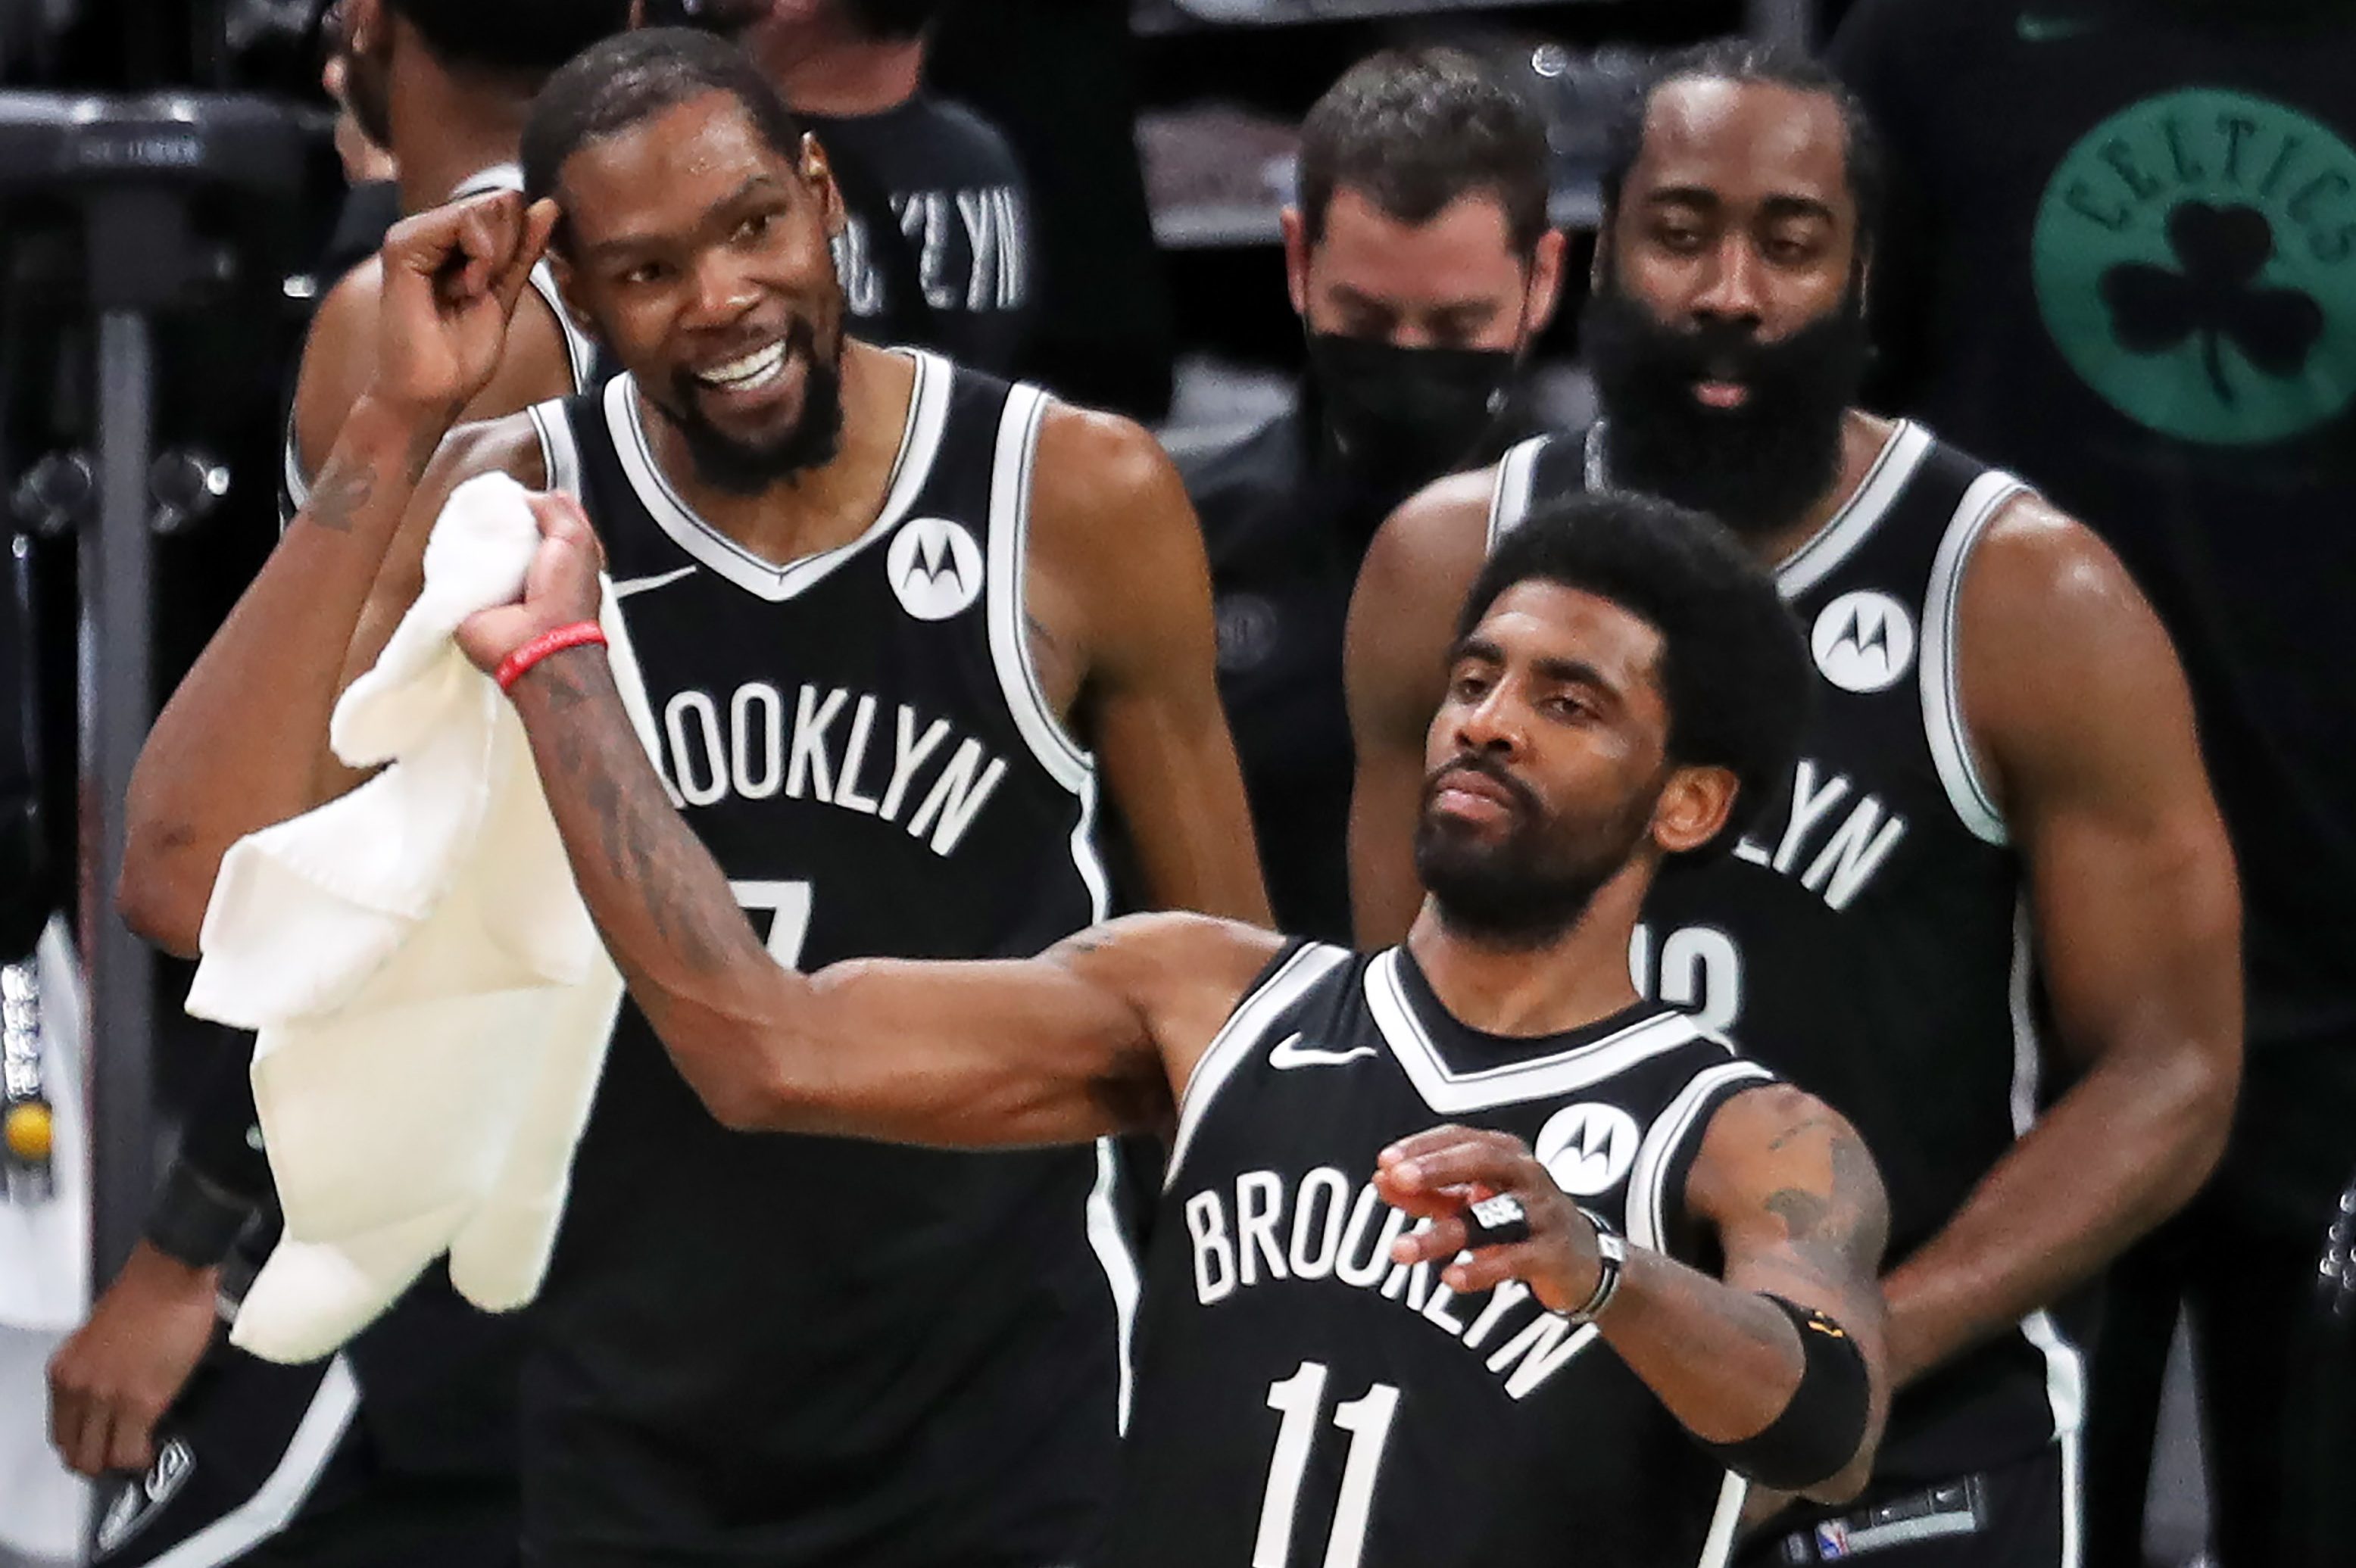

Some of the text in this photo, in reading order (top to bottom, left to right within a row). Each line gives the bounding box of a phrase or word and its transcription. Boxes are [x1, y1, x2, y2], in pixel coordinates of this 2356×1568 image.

[2064, 112, 2355, 263] CELTICS
[663, 682, 1007, 858] OOKLYN
[1251, 1361, 1401, 1568] 11
